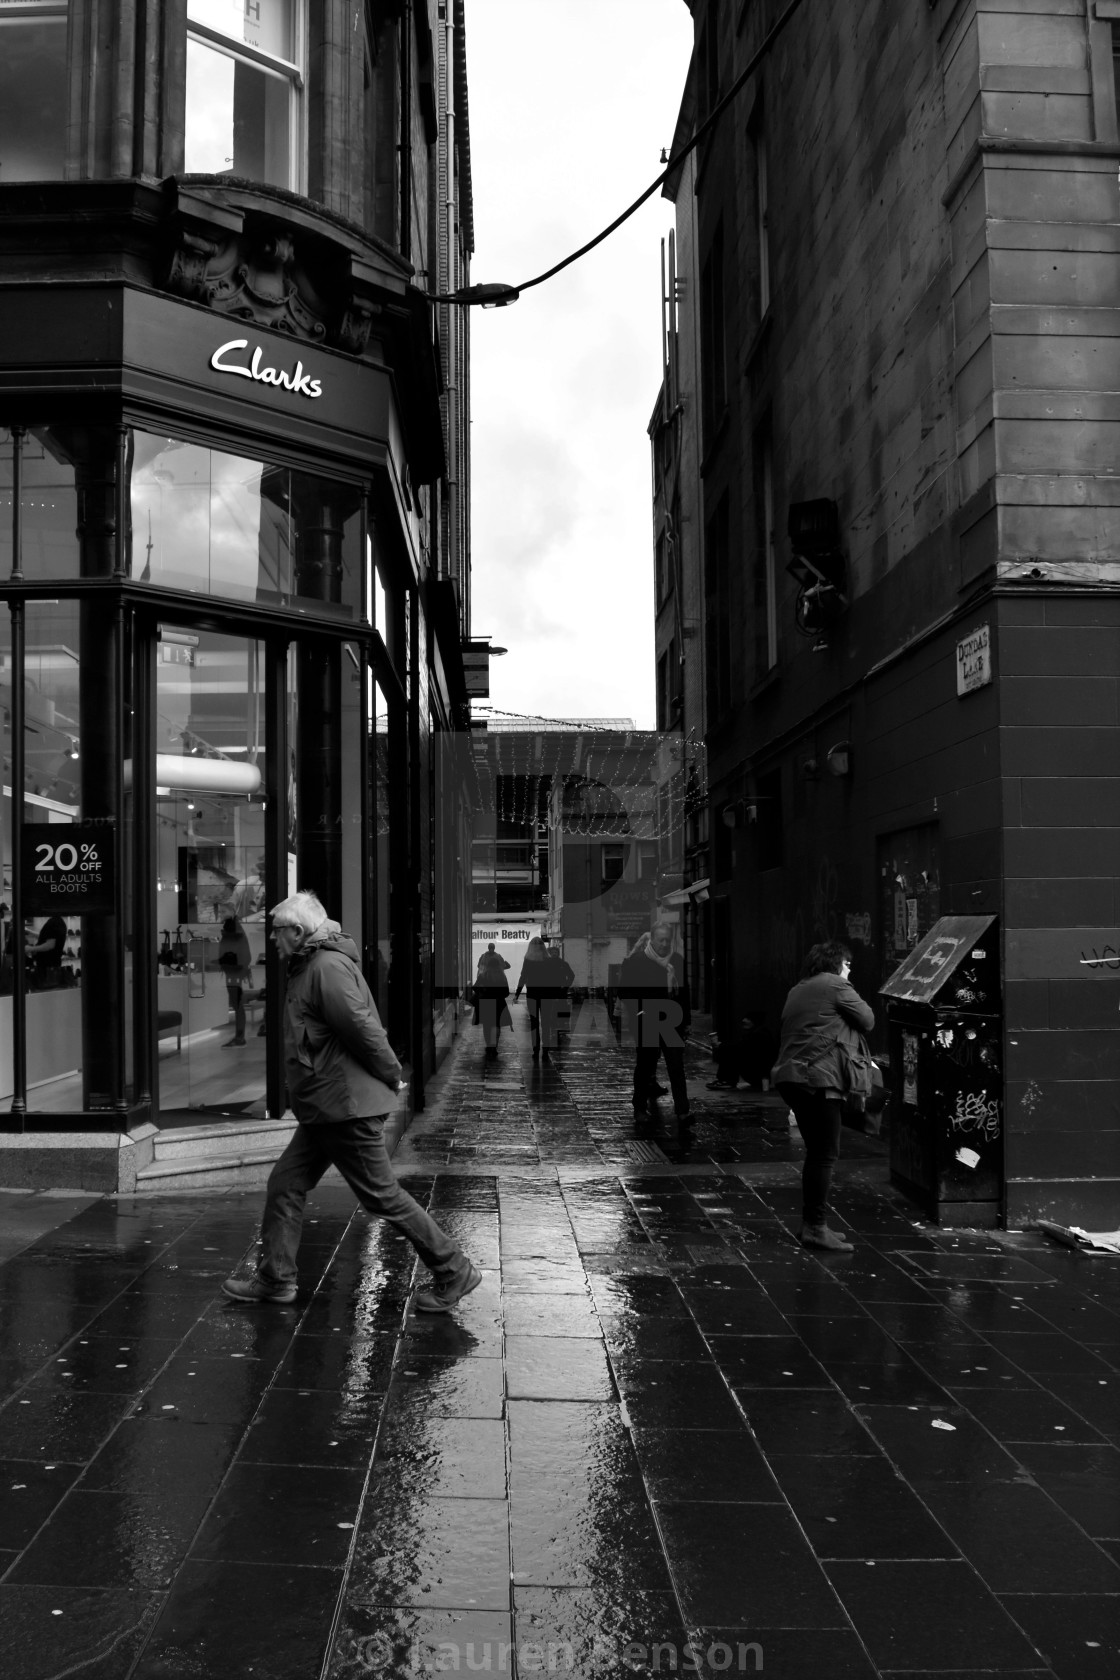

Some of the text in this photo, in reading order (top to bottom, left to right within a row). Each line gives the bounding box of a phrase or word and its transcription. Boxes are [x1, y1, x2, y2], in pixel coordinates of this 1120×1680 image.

[211, 338, 323, 398] Clarks
[80, 861, 102, 871] OFF
[35, 873, 102, 883] ALL ADULTS
[50, 883, 88, 893] BOOTS
[472, 929, 530, 940] alfour Beatty
